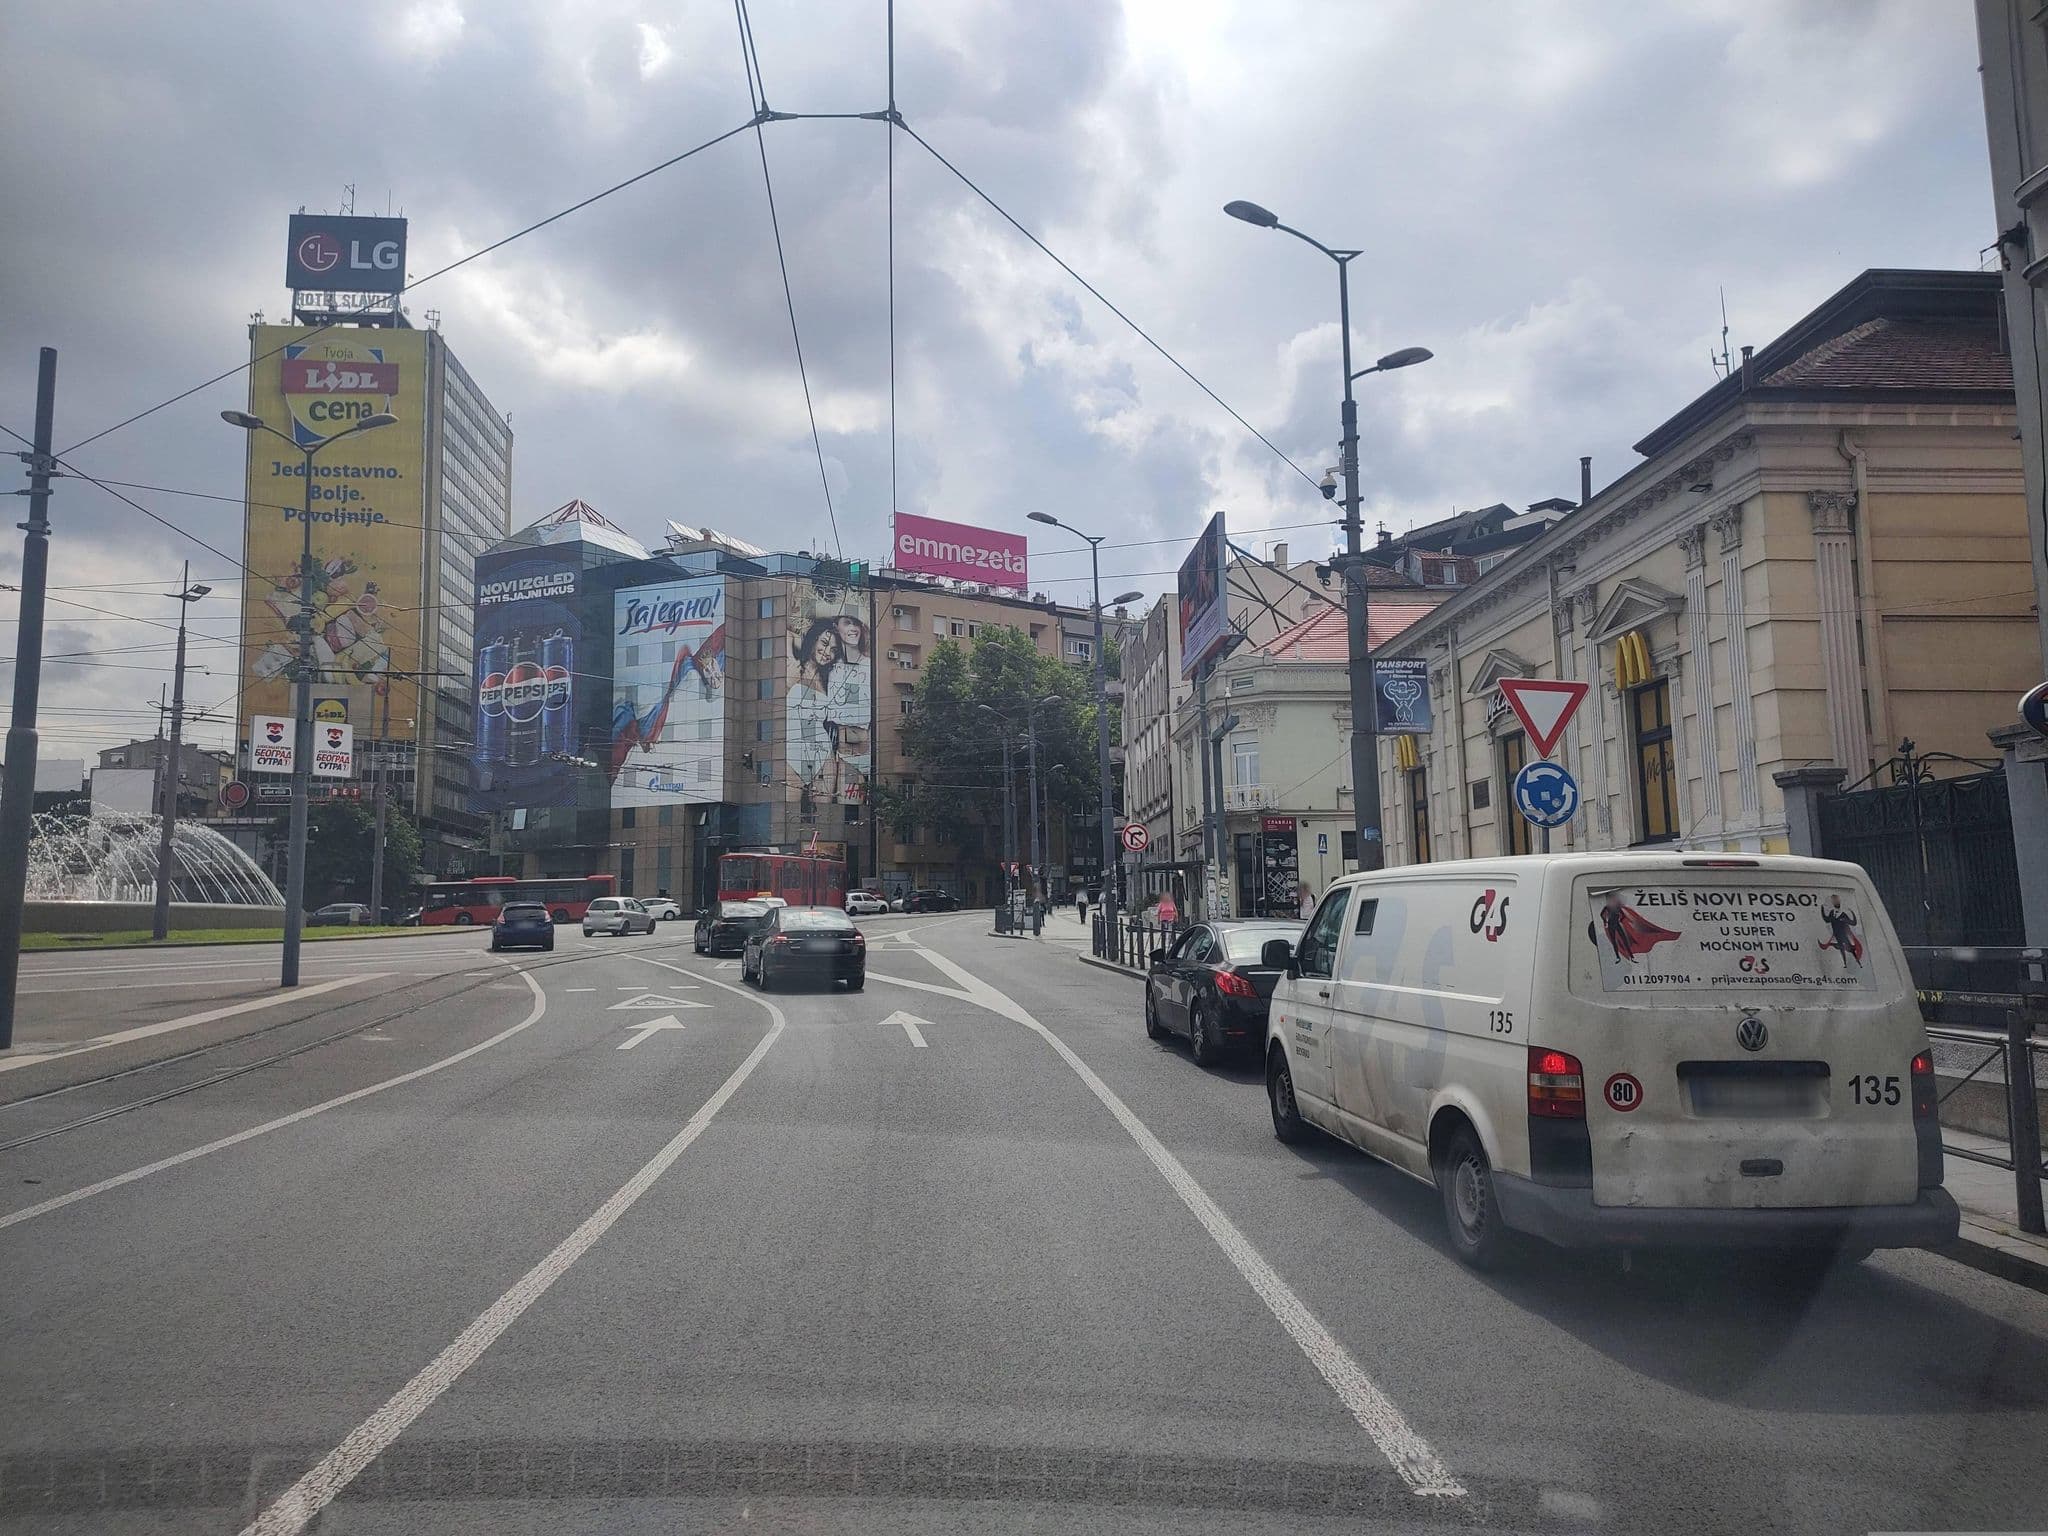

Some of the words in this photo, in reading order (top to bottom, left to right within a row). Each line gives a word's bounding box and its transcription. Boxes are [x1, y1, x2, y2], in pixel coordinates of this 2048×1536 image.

[351, 241, 398, 270] LG
[324, 347, 353, 360] Tvoja
[309, 400, 373, 421] cena
[272, 461, 403, 479] Jednostavno.
[310, 485, 365, 503] Bolje.
[284, 508, 389, 526] Povoljnije.
[900, 534, 1025, 573] emmezeta
[480, 580, 517, 597] NOVI
[519, 572, 575, 591] IZGLED
[480, 595, 501, 605] ISTI
[502, 589, 542, 602] SJAJNI
[543, 584, 575, 596] UKUS
[504, 684, 546, 699] PEPSI
[255, 749, 292, 759] БЕОГРАД
[257, 758, 282, 766] СУТРА
[317, 754, 350, 764] БЕОГРАД
[319, 762, 341, 770] СУТРА
[1635, 890, 1689, 907] ŽELIŠ
[1694, 893, 1742, 906] NOVI
[1749, 893, 1818, 907] POSAO?
[1470, 889, 1510, 942] G4S
[1693, 909, 1727, 922] ČEKA
[1731, 912, 1748, 922] TE
[1752, 912, 1796, 922] MESTO
[1720, 927, 1730, 936] U
[1734, 927, 1776, 936] SUPER
[1700, 939, 1763, 951] MOĆNOM
[1767, 942, 1800, 951] TIMU
[1624, 975, 1690, 985] 0112097904
[1711, 973, 1858, 986] prijavezaposao@rs.g4s.com
[1489, 1010, 1513, 1034] 135
[1612, 1083, 1634, 1102] 80
[1848, 1074, 1901, 1106] 135
